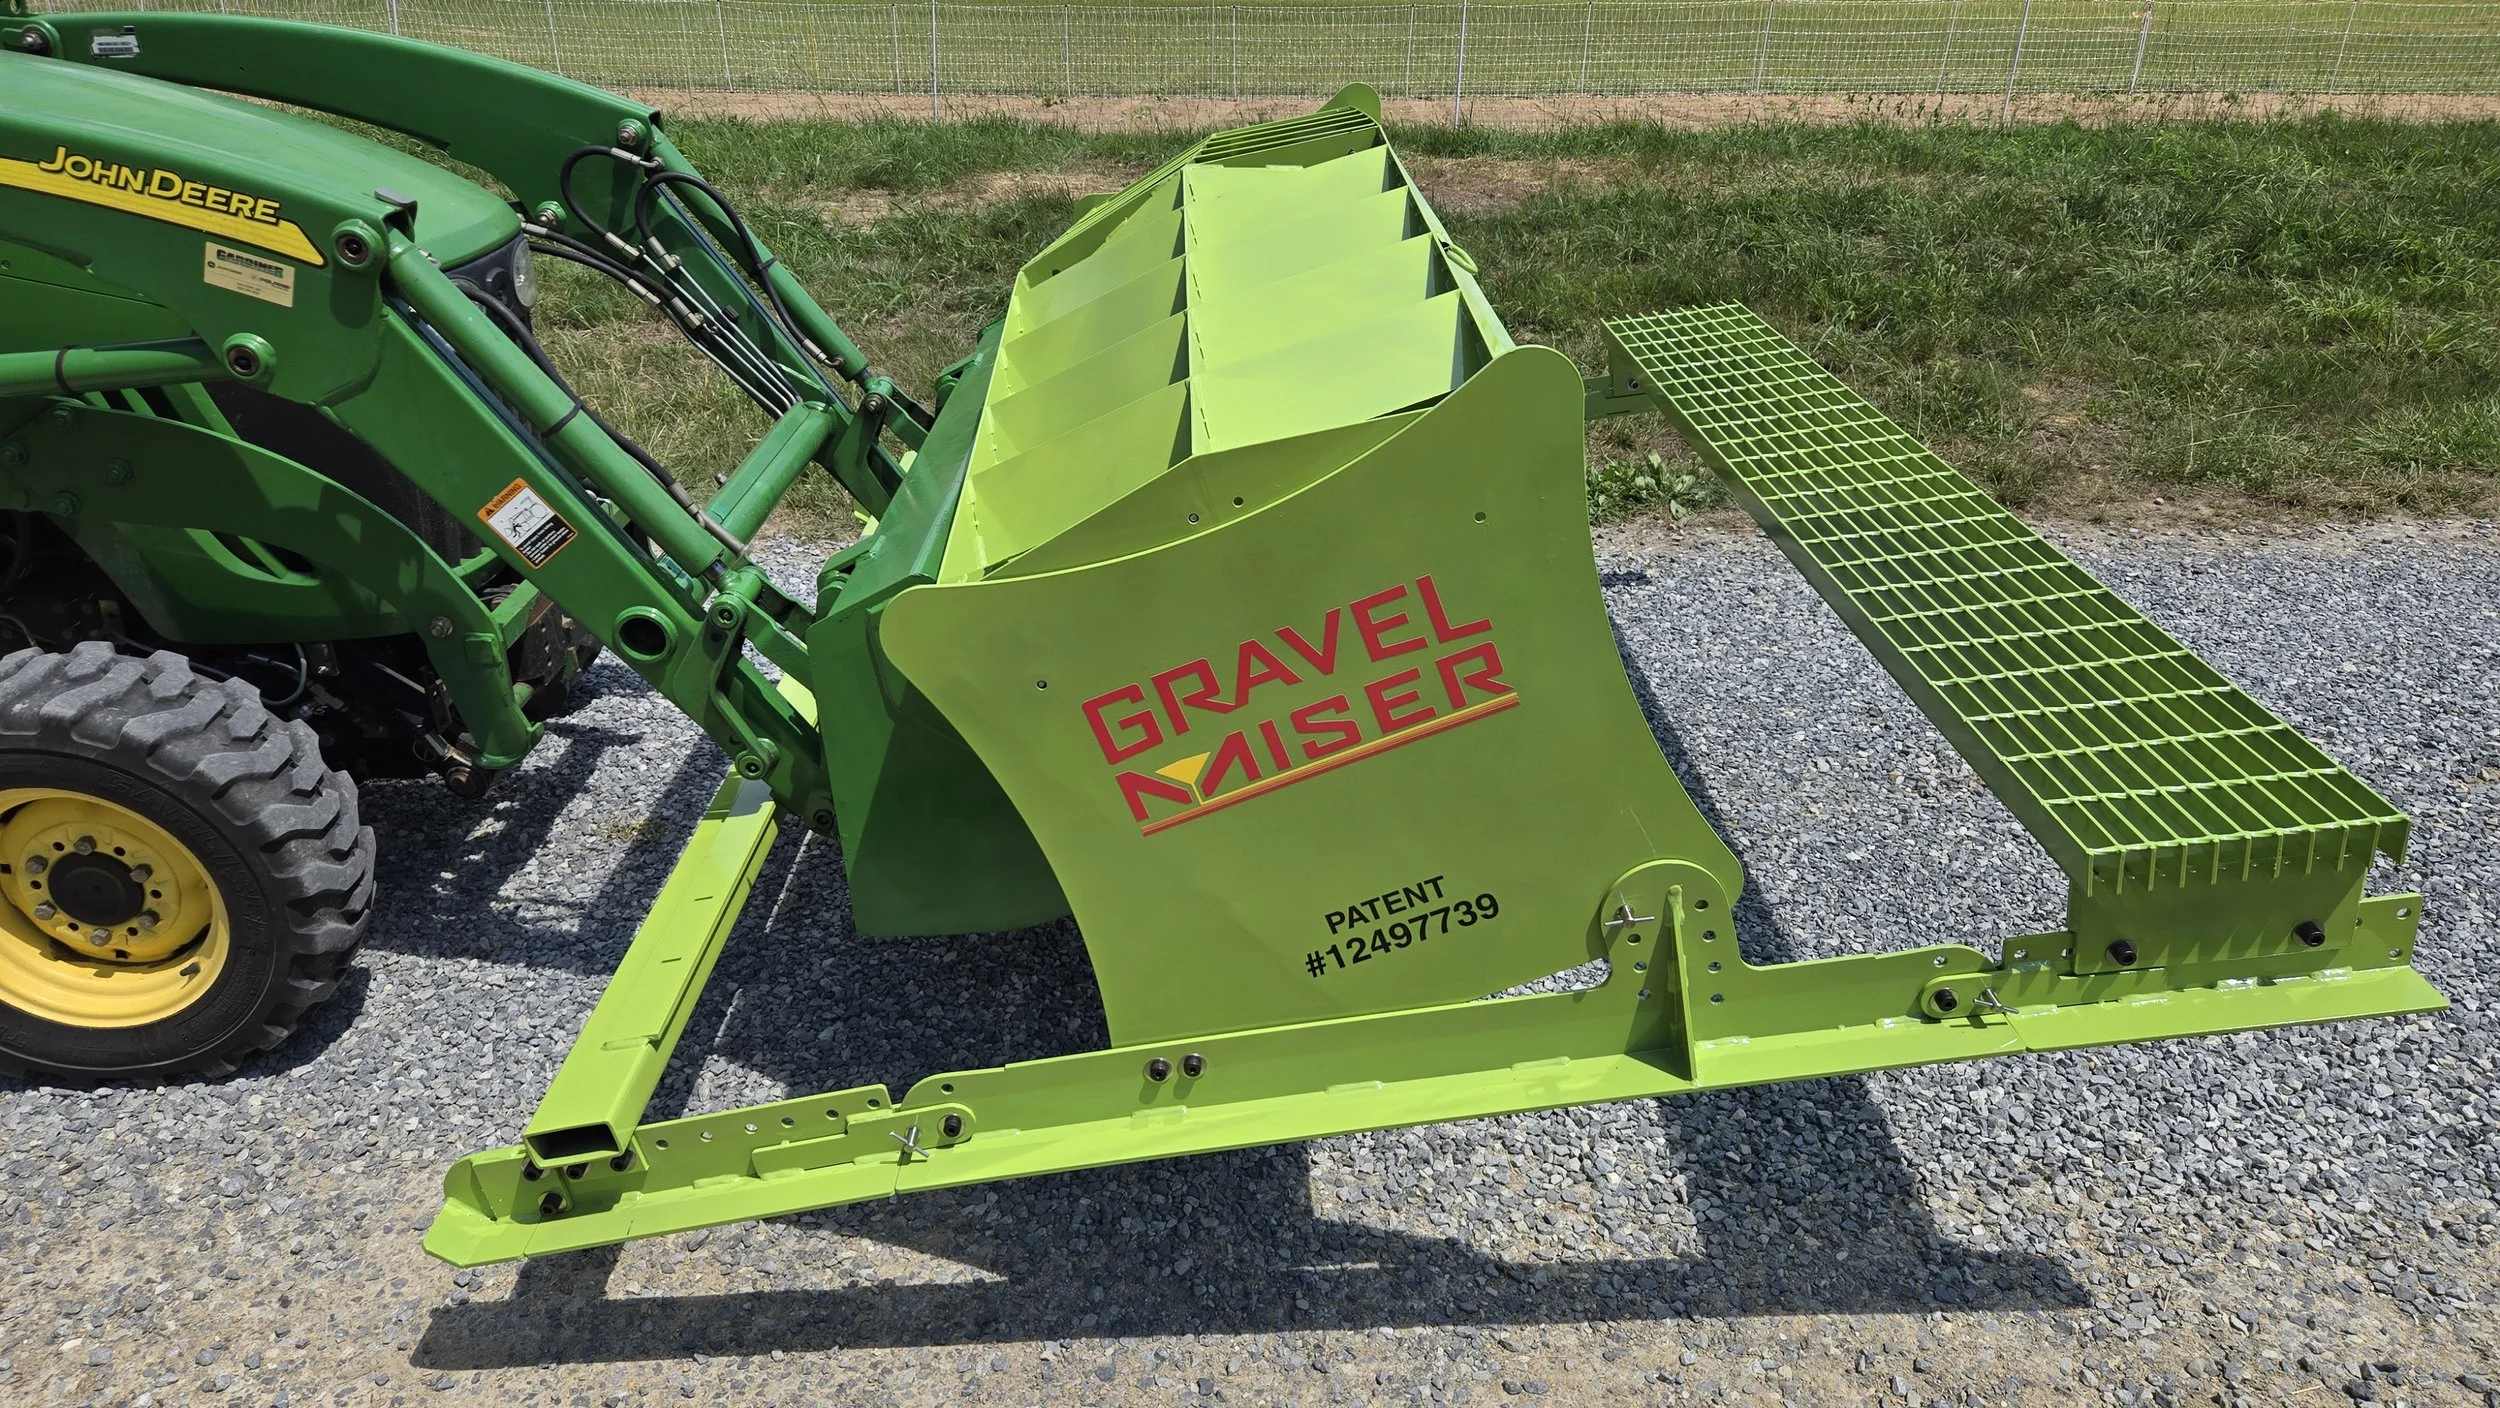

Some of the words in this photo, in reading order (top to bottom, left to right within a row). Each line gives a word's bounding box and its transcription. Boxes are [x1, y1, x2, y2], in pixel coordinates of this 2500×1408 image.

[38, 146, 147, 193] JOHN
[149, 169, 281, 224] DEERE
[493, 482, 521, 508] WARNING
[1081, 574, 1493, 766] GRAVEL
[1115, 641, 1516, 822] MISER
[1305, 893, 1500, 978] #12497739
[1325, 875, 1445, 935] PATENT
